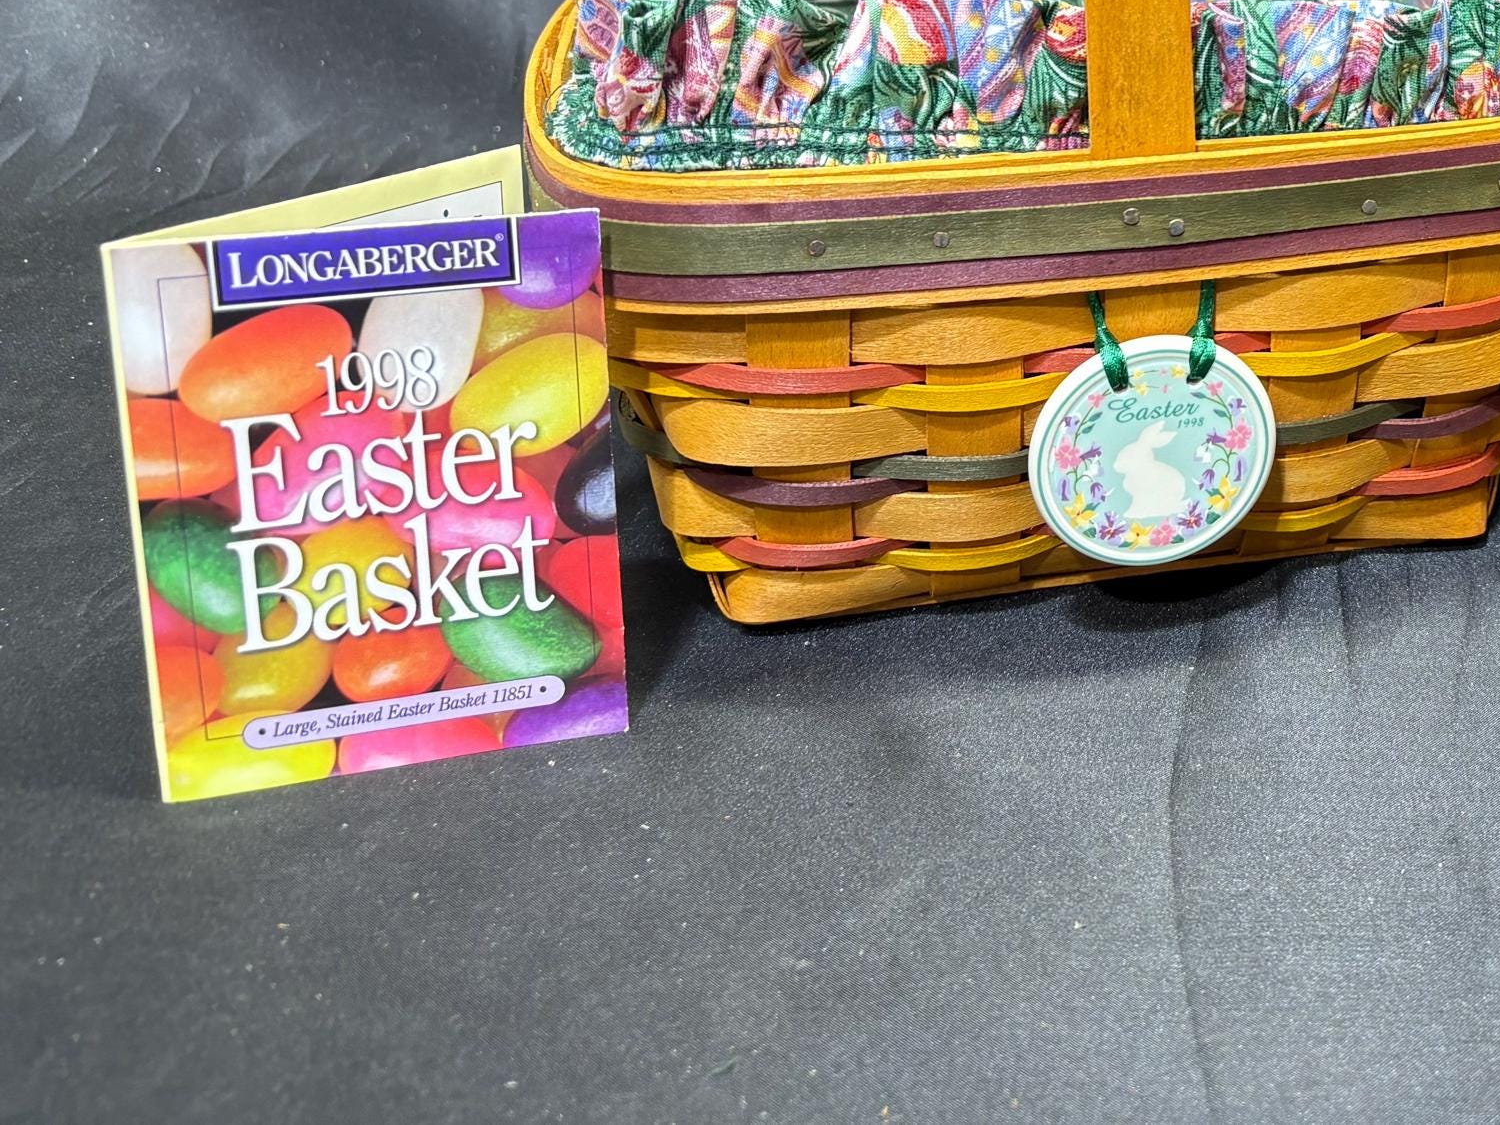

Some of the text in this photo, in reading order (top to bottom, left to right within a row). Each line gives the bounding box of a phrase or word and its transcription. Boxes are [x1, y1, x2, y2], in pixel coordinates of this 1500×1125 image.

[316, 346, 437, 416] 1998
[1108, 397, 1199, 423] Easter
[1178, 417, 1205, 428] 1998
[221, 410, 537, 533] Easter
[226, 513, 555, 653] Basket
[273, 685, 532, 737] Large, Stained Easter Basket 11851
